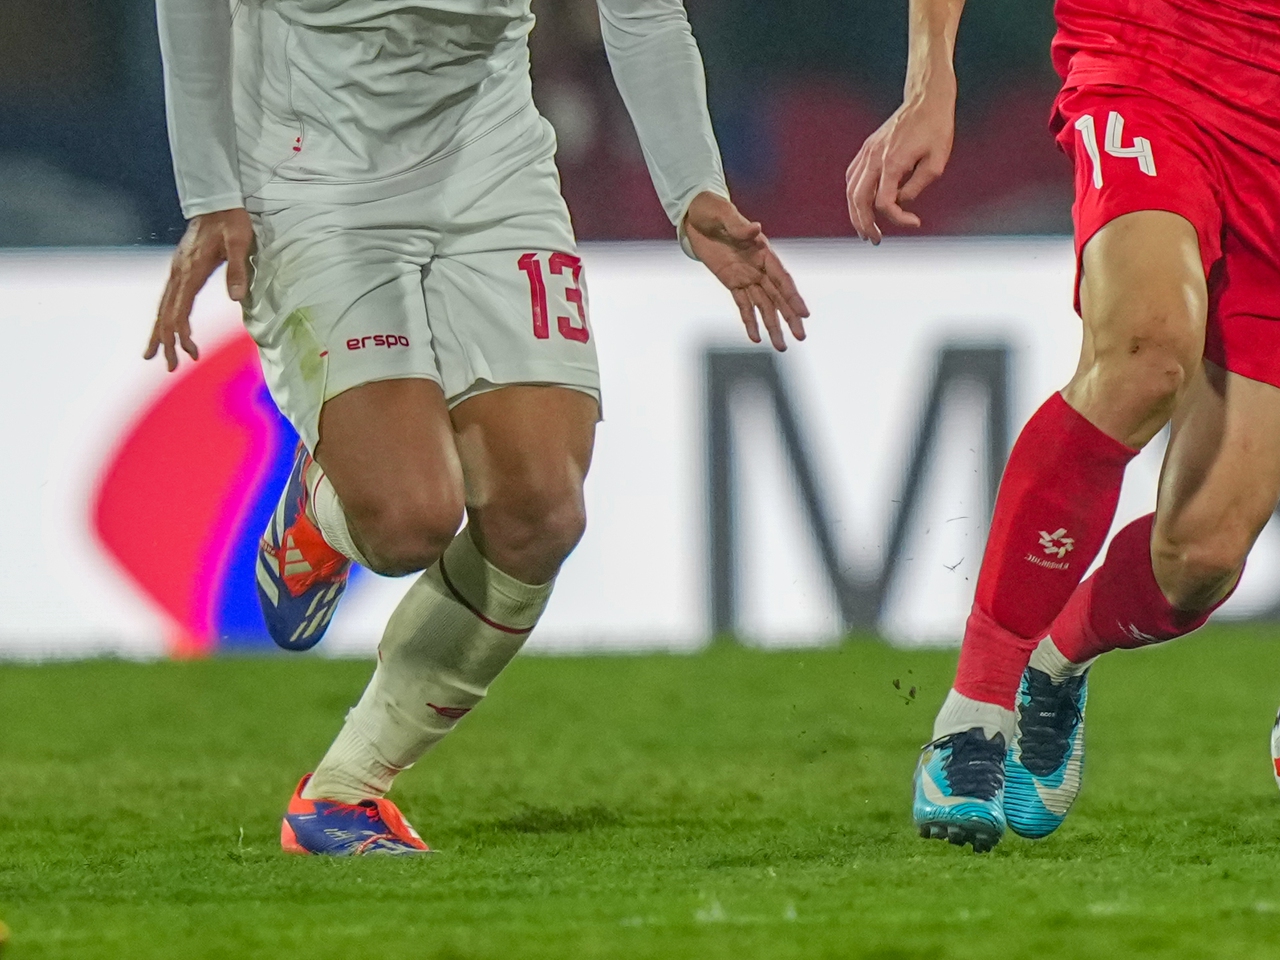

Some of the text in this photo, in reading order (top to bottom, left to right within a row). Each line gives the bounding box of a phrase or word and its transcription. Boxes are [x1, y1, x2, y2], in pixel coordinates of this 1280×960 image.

[1074, 111, 1158, 190] 14
[517, 252, 590, 344] 13
[346, 334, 410, 351] erspo
